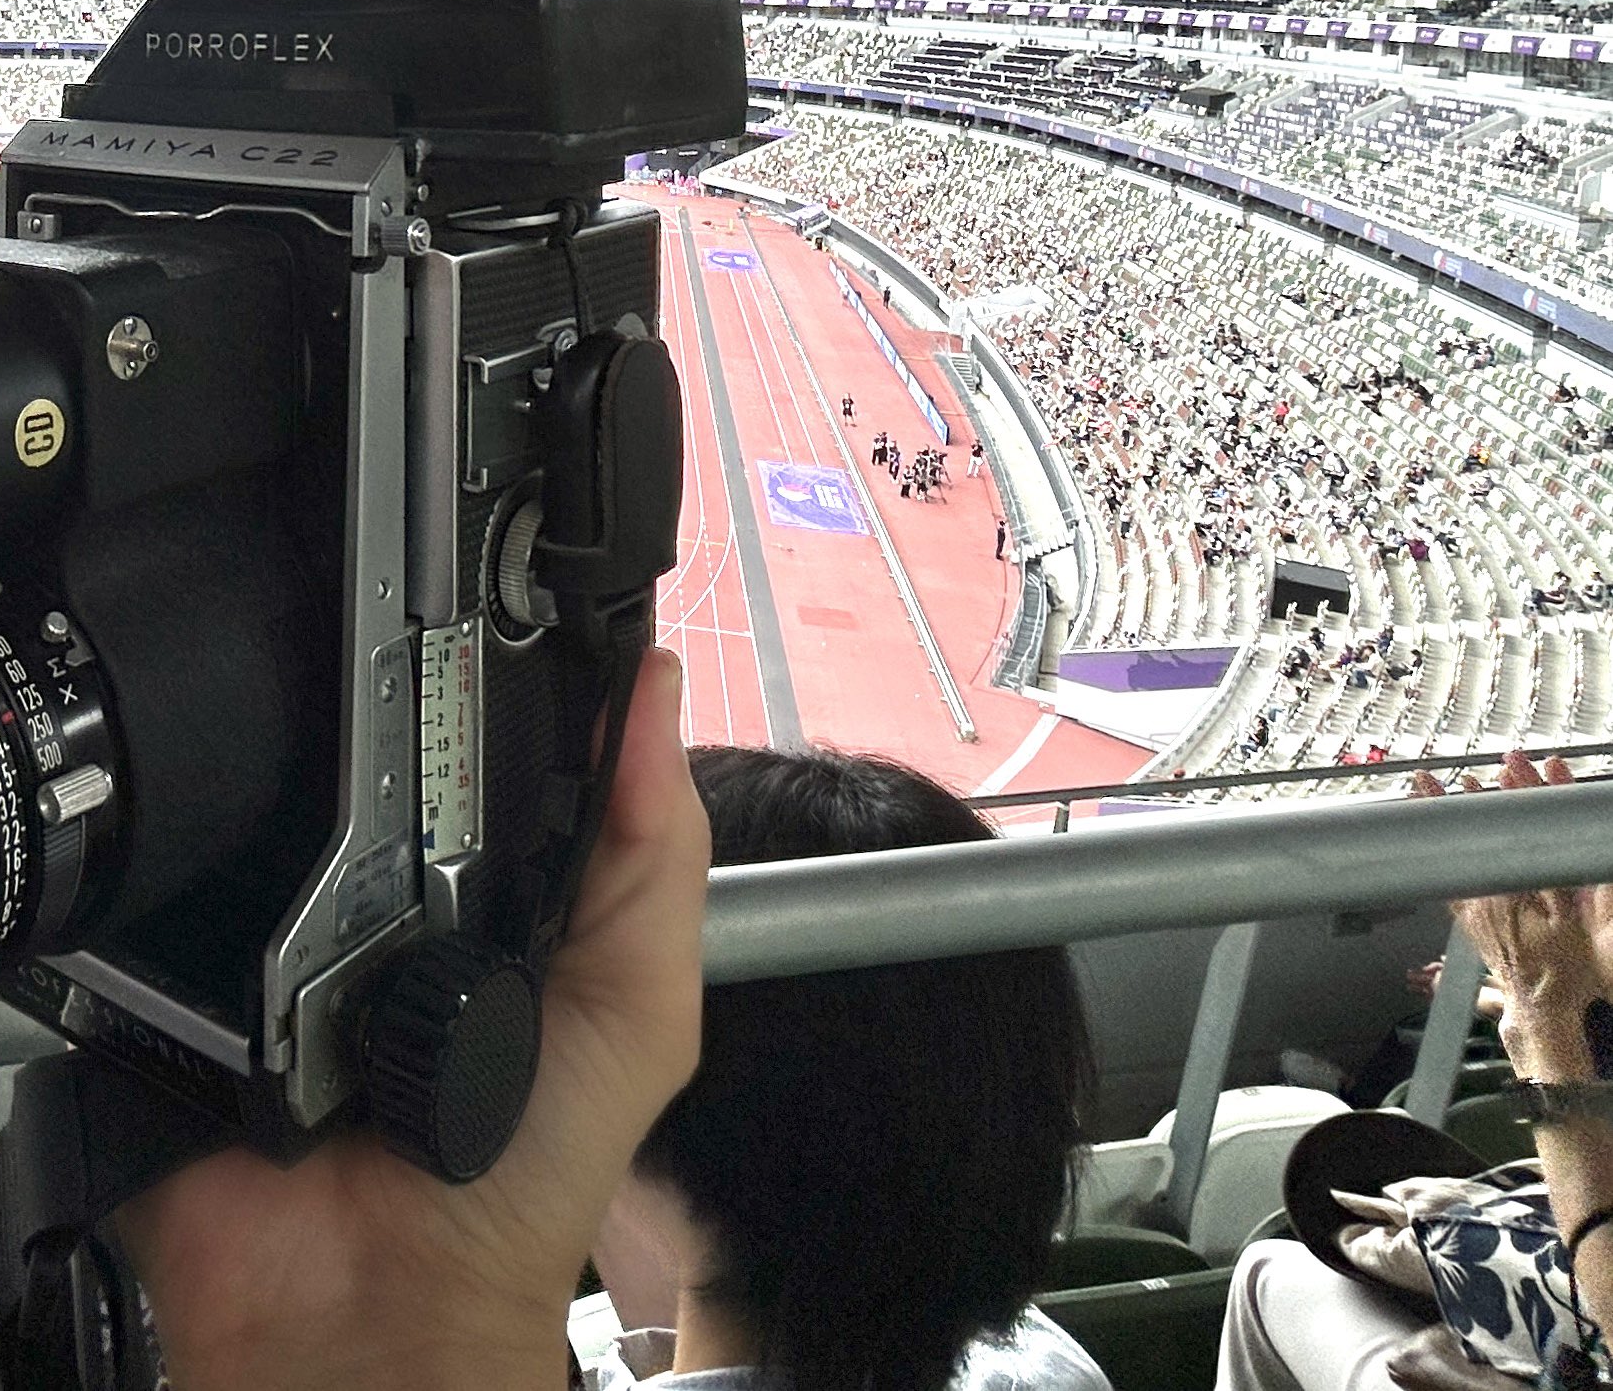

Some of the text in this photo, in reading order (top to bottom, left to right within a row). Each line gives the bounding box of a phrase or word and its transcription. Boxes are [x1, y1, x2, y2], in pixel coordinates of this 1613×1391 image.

[146, 33, 334, 60] PORROFLEX
[39, 132, 339, 167] MAMIYA C22
[25, 412, 54, 456] CD
[439, 648, 450, 664] 10
[5, 659, 27, 684] 60
[438, 666, 443, 679] 5
[17, 683, 43, 712] 125
[59, 683, 78, 705] X
[27, 711, 54, 743] 250
[438, 712, 443, 727] 2
[458, 732, 464, 746] 5
[37, 741, 63, 772] 500
[429, 806, 439, 820] m
[2, 819, 21, 849] 22
[6, 847, 21, 876] 16
